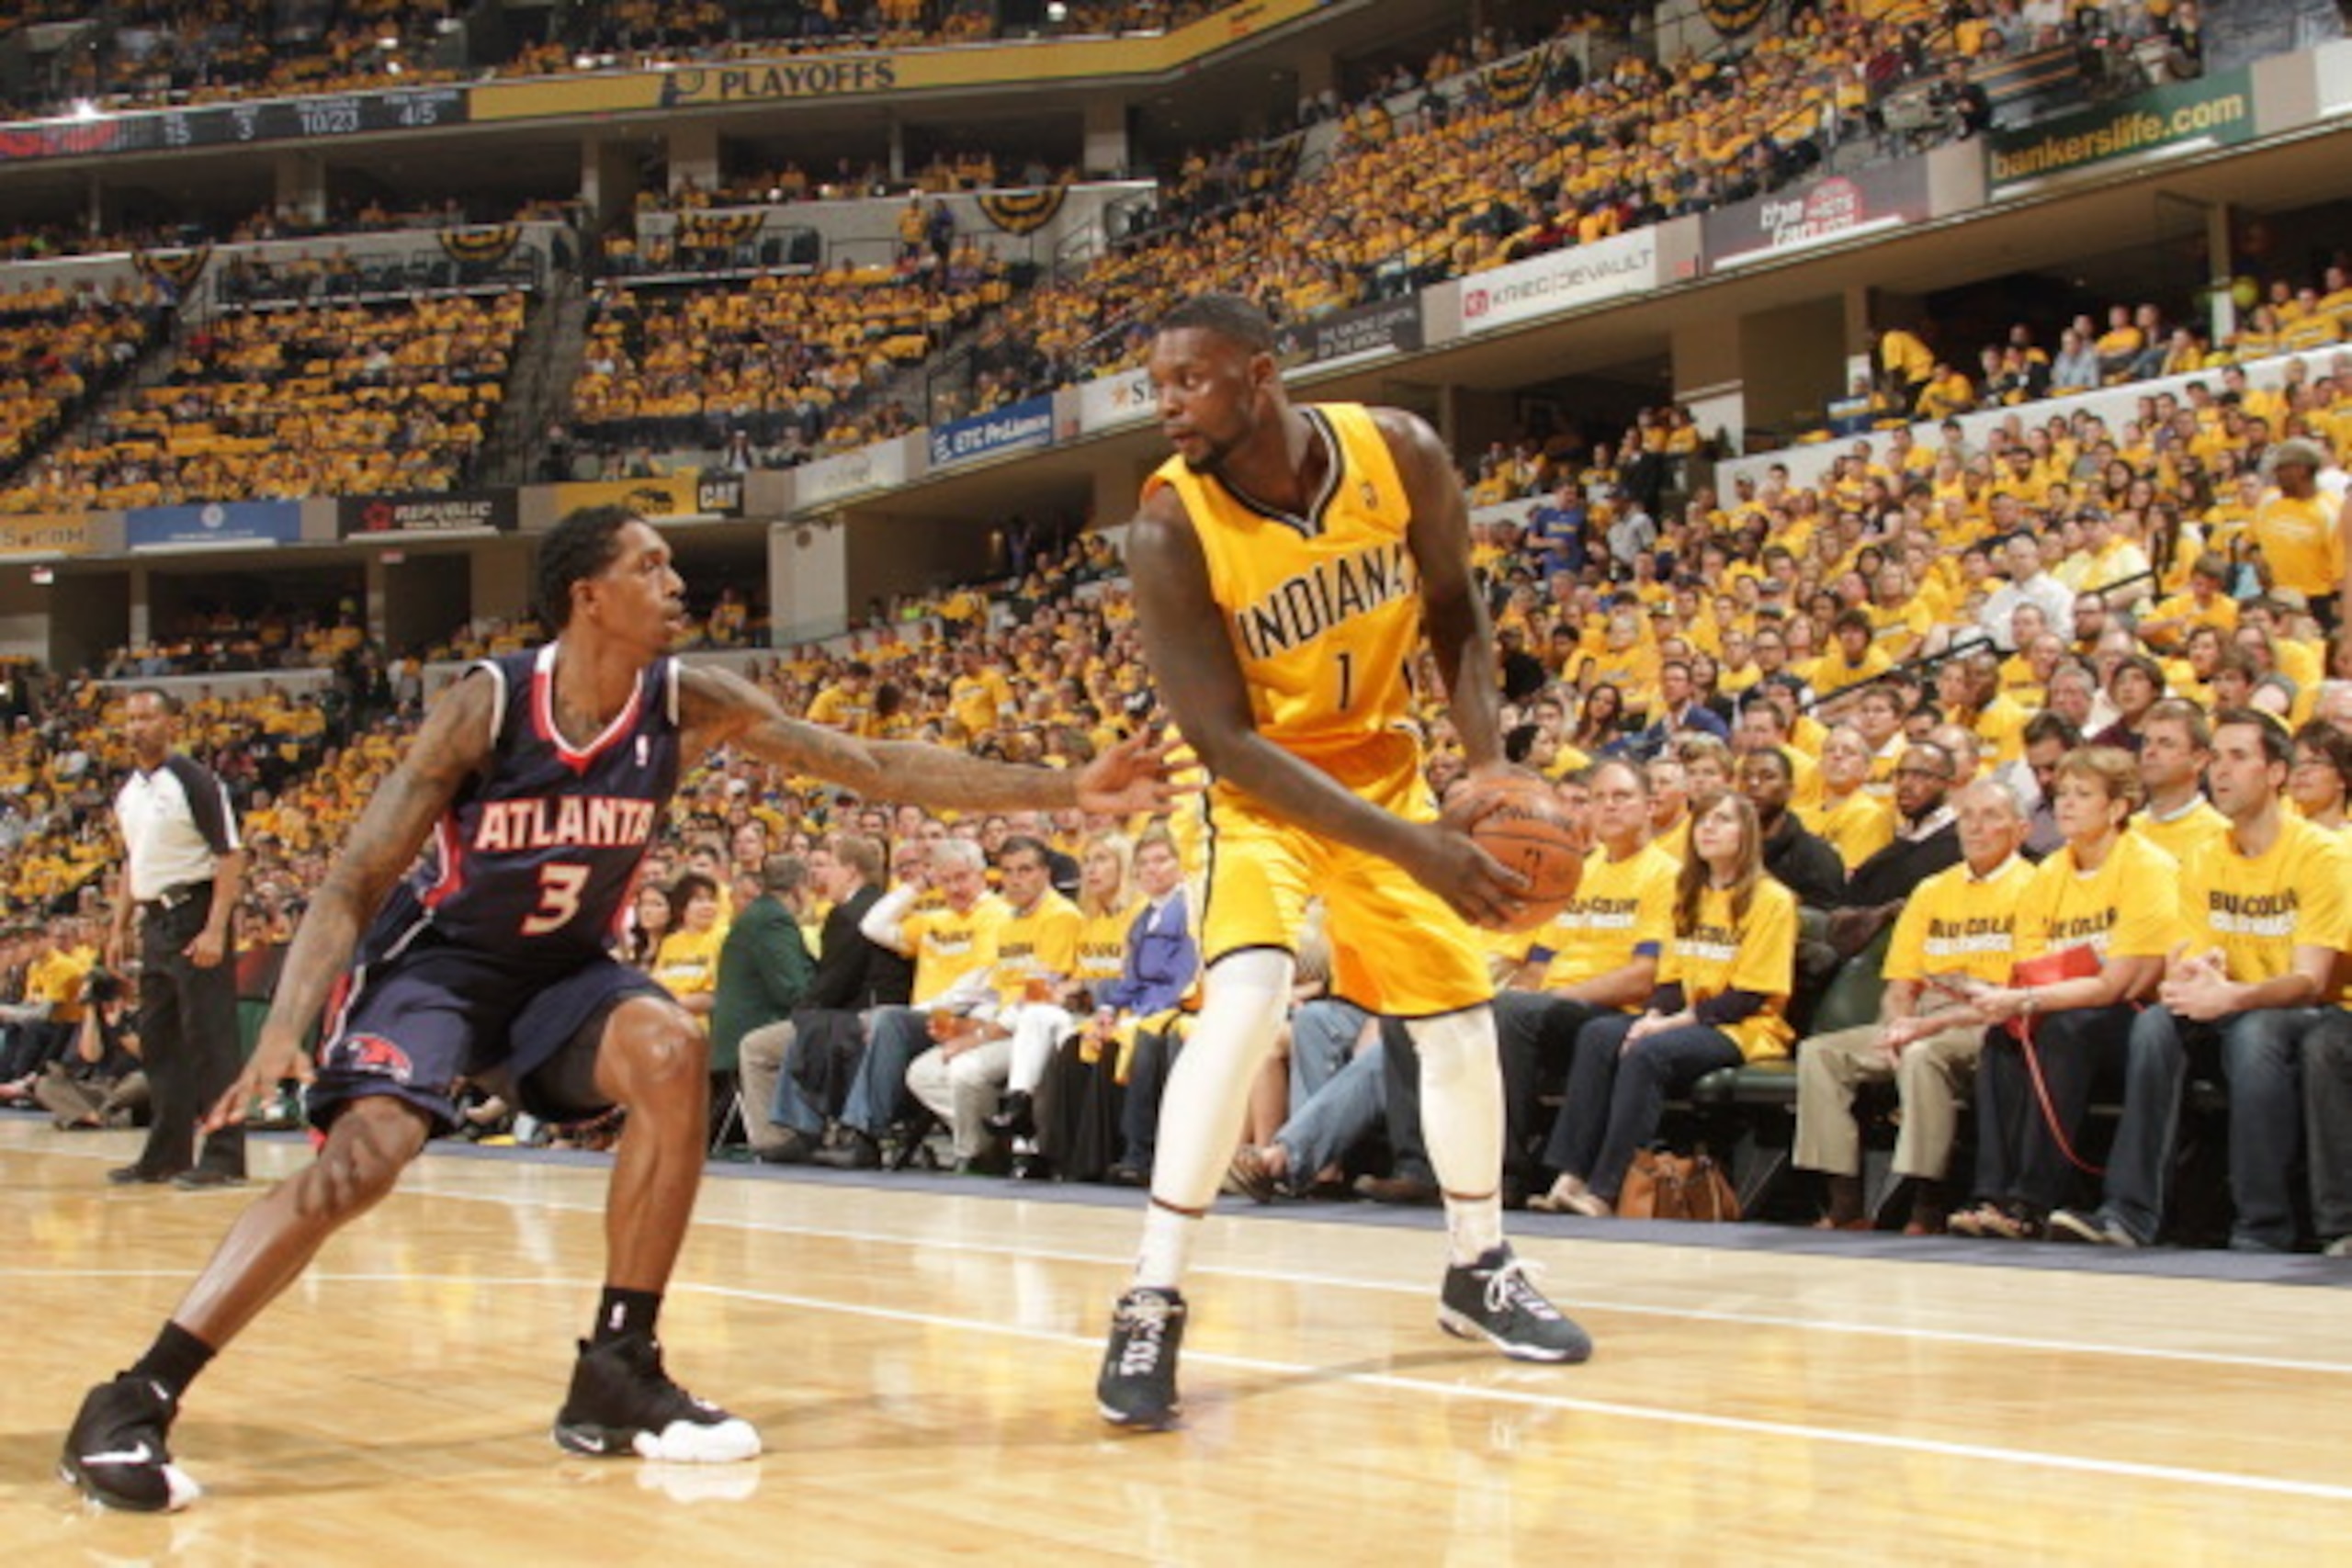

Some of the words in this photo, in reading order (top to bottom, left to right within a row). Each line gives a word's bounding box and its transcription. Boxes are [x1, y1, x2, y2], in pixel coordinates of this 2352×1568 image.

[720, 59, 895, 98] PLAYOFFS
[237, 116, 254, 140] 3
[300, 109, 361, 135] 10/23
[399, 103, 437, 126] 4/5
[1990, 93, 2244, 181] bankerslife.com
[699, 477, 741, 508] CAT
[1337, 650, 1352, 711] 1
[518, 860, 593, 937] 3
